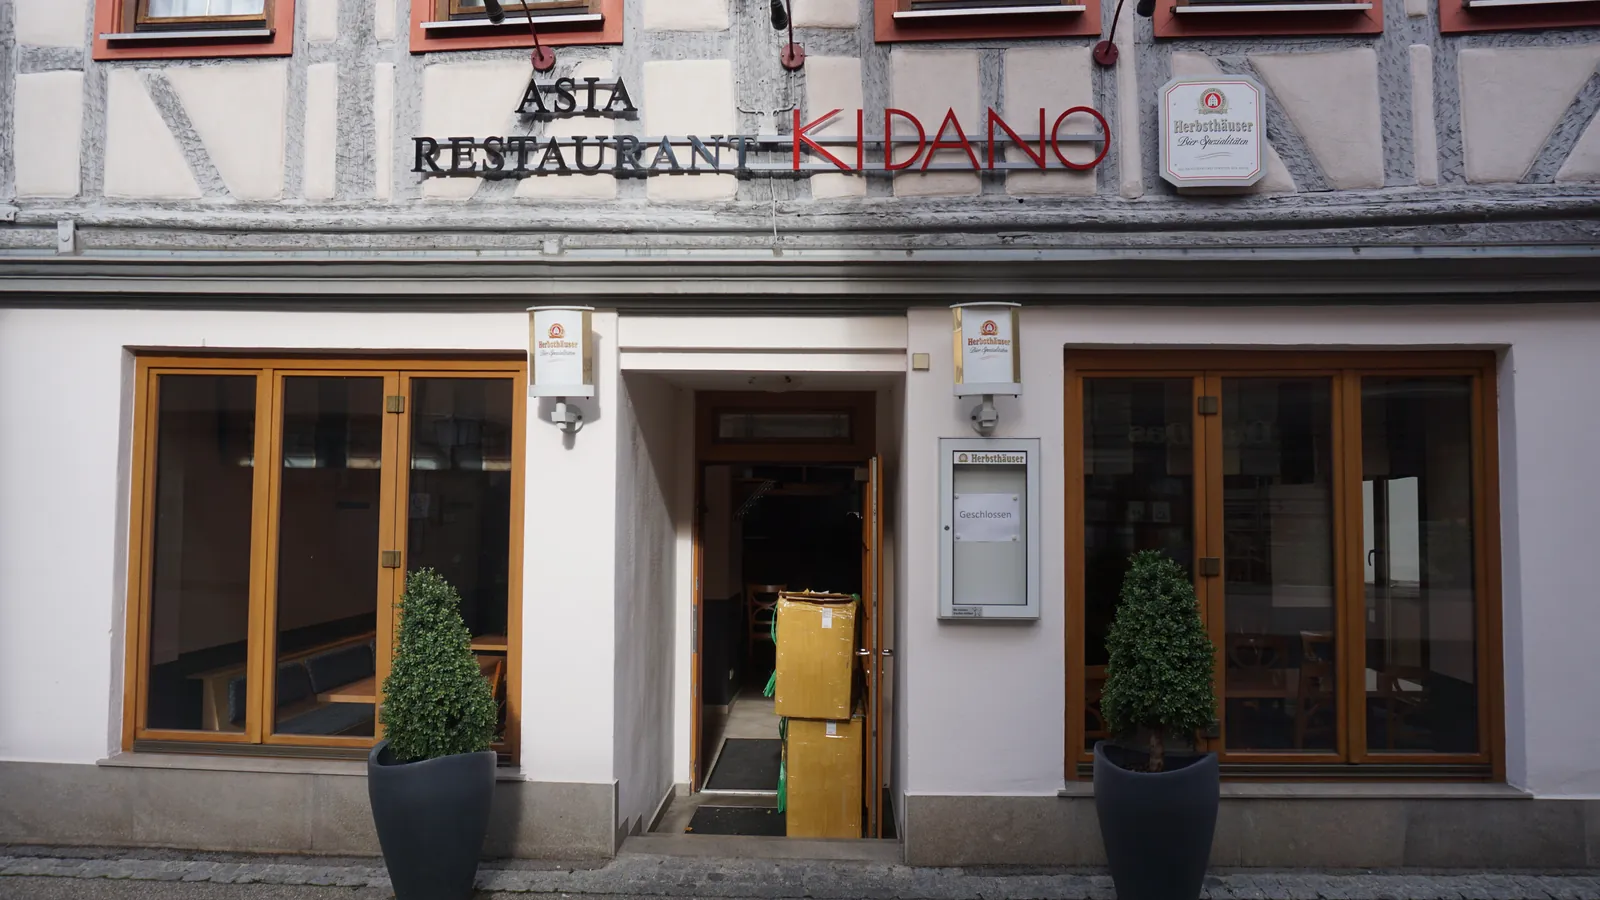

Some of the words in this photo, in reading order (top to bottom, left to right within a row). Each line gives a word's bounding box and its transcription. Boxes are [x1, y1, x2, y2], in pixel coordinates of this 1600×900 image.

[515, 76, 638, 114] ASIA
[1173, 119, 1254, 133] Herbsthäuser
[410, 134, 758, 175] RESTAURANT
[793, 106, 1111, 171] KIDANO
[1177, 136, 1198, 147] Bier
[1200, 135, 1248, 149] Spezialitäten
[971, 453, 1024, 463] Herbsthäuser
[959, 510, 1012, 519] Geschlossen
